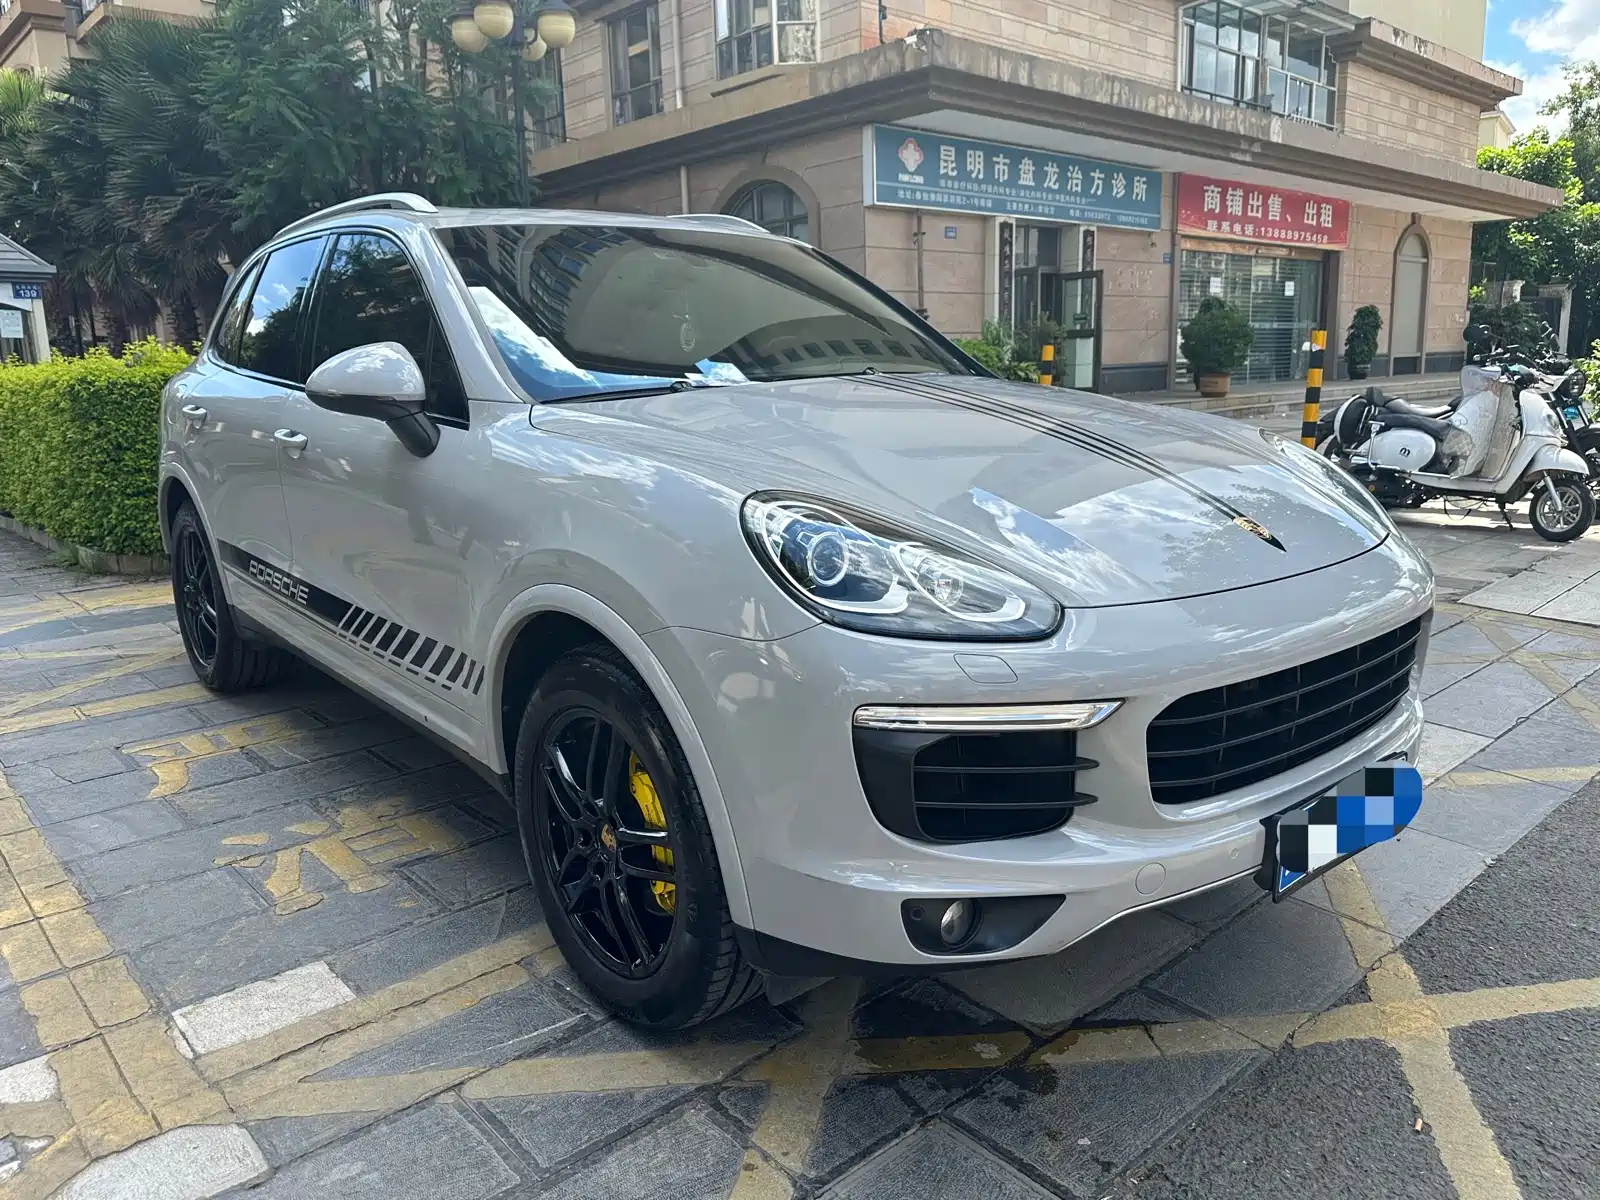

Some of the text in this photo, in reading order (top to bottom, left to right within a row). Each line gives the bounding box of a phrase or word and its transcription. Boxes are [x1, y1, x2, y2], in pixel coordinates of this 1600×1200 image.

[939, 144, 1148, 203] 昆明市盘龙治方诊所
[1202, 184, 1333, 228] 商铺出售、出租
[19, 289, 37, 298] 139
[248, 559, 309, 605] PORSCHE
